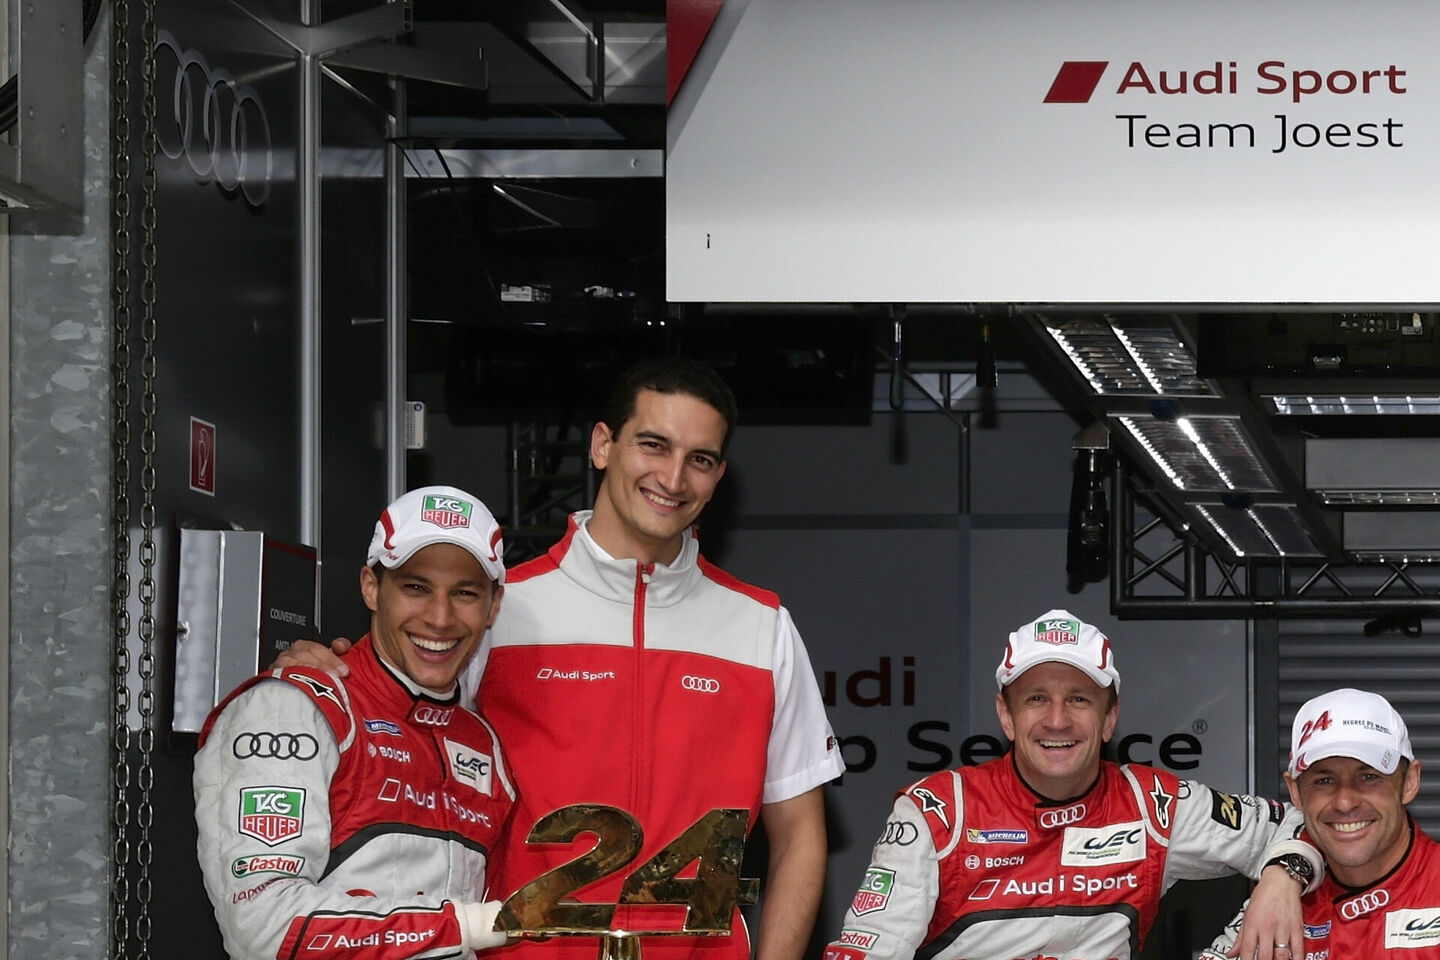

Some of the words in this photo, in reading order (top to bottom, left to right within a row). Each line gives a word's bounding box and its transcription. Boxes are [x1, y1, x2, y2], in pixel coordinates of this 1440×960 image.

[1116, 61, 1238, 95] Audi
[1256, 60, 1407, 104] Sport
[1115, 114, 1255, 148] Team
[1272, 114, 1403, 153] Joest
[433, 497, 464, 512] TAG
[425, 511, 467, 526] HEUER
[1043, 620, 1073, 630] TAG
[1039, 631, 1075, 643] HEUER
[553, 670, 579, 679] Audi
[582, 671, 615, 681] Sport
[1298, 710, 1333, 749] 24
[252, 793, 293, 814] TAG
[245, 817, 299, 840] HEUER
[988, 832, 1026, 840] MICHELIN
[1084, 828, 1142, 850] WEC
[248, 857, 300, 874] Castrol
[492, 803, 760, 936] 24
[985, 855, 1025, 868] BOSCH
[1002, 874, 1065, 896] Audi
[1071, 872, 1138, 898] Sport
[334, 930, 379, 948] Audi
[384, 928, 435, 949] Sport
